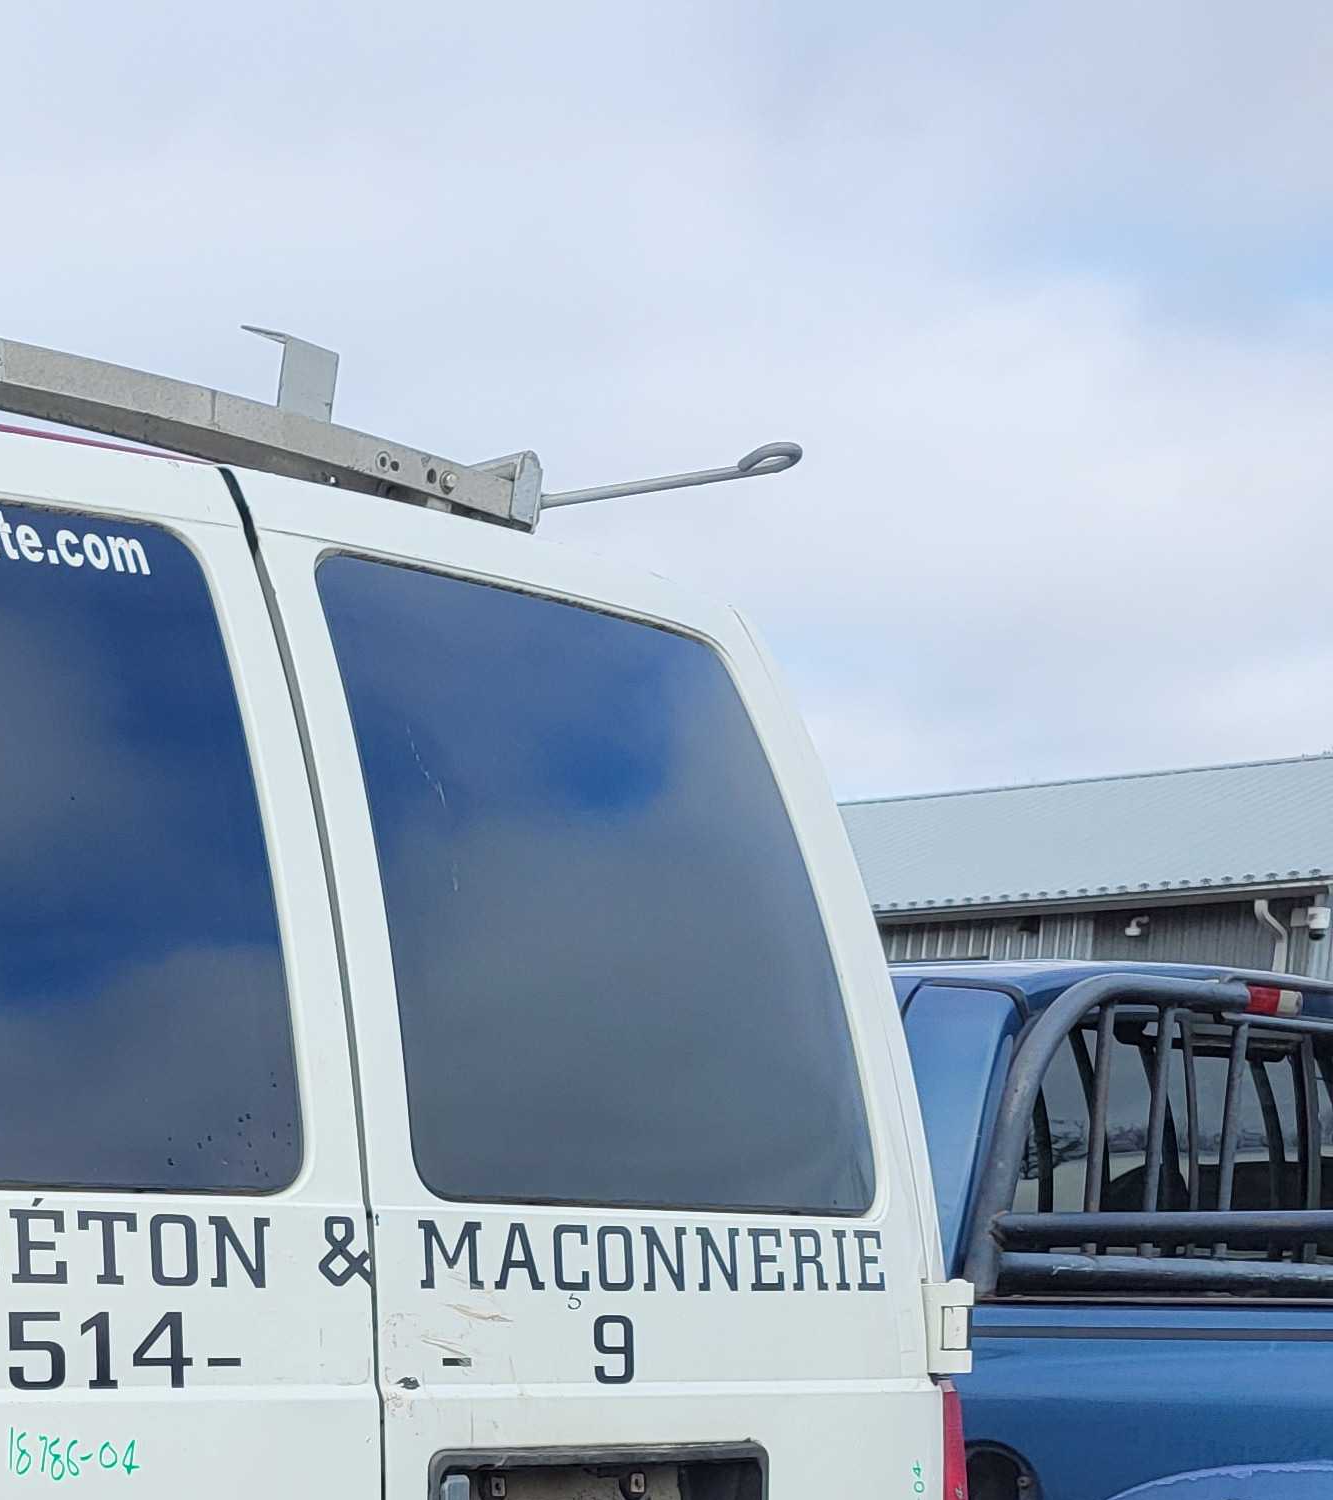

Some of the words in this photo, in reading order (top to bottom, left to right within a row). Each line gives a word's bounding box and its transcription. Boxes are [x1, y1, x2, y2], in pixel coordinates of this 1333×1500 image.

[318, 1216, 373, 1288] &
[418, 1219, 886, 1310] MAÇONNERIE
[8, 1312, 241, 1390] 514-
[594, 1314, 635, 1384] 9
